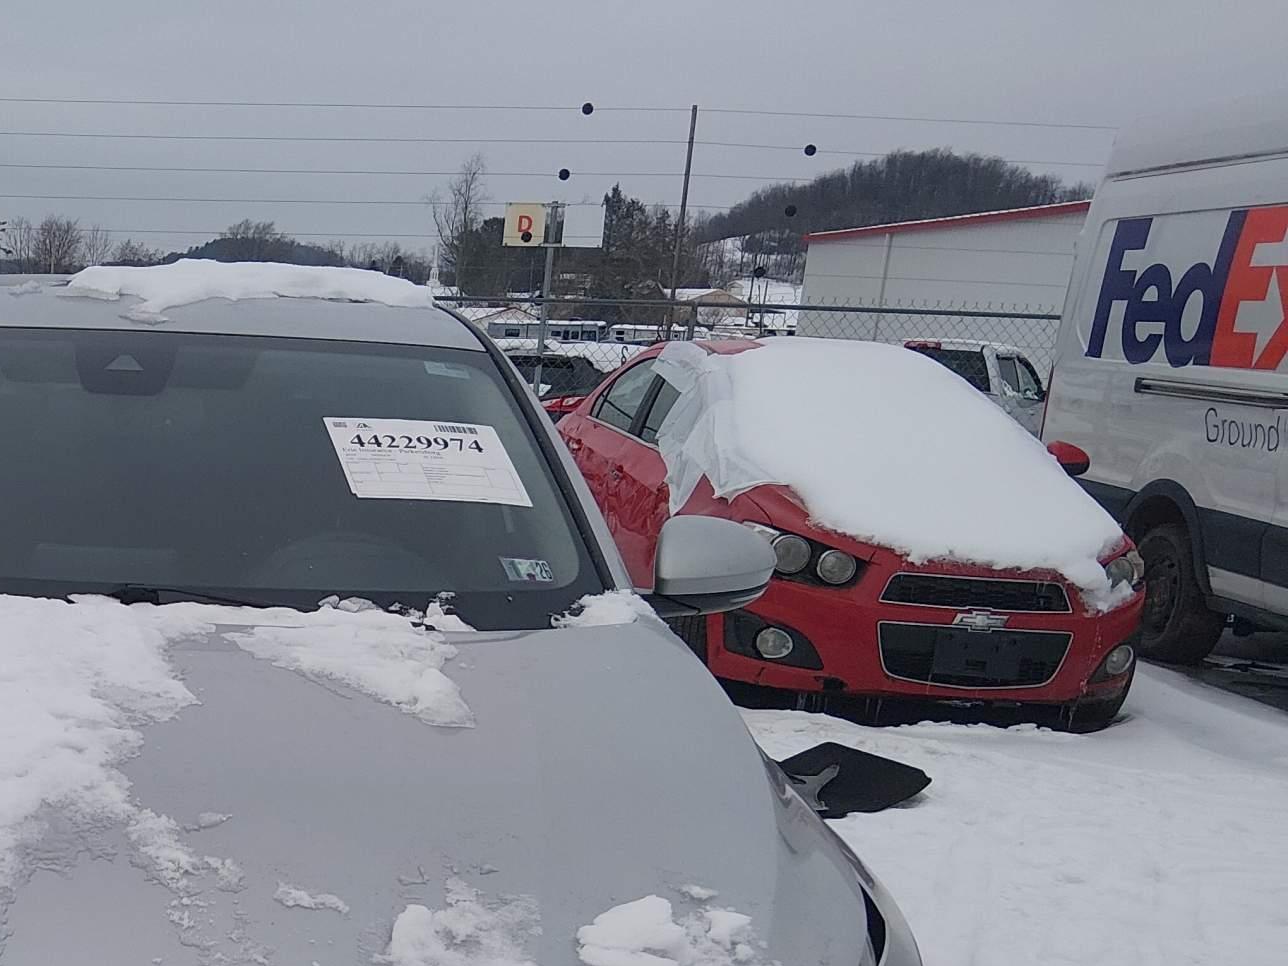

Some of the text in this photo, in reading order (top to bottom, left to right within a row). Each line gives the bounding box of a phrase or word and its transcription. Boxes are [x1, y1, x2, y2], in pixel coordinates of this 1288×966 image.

[518, 215, 533, 232] D
[1204, 407, 1281, 452] Ground
[350, 433, 484, 453] 44229974
[535, 561, 553, 580] 26
